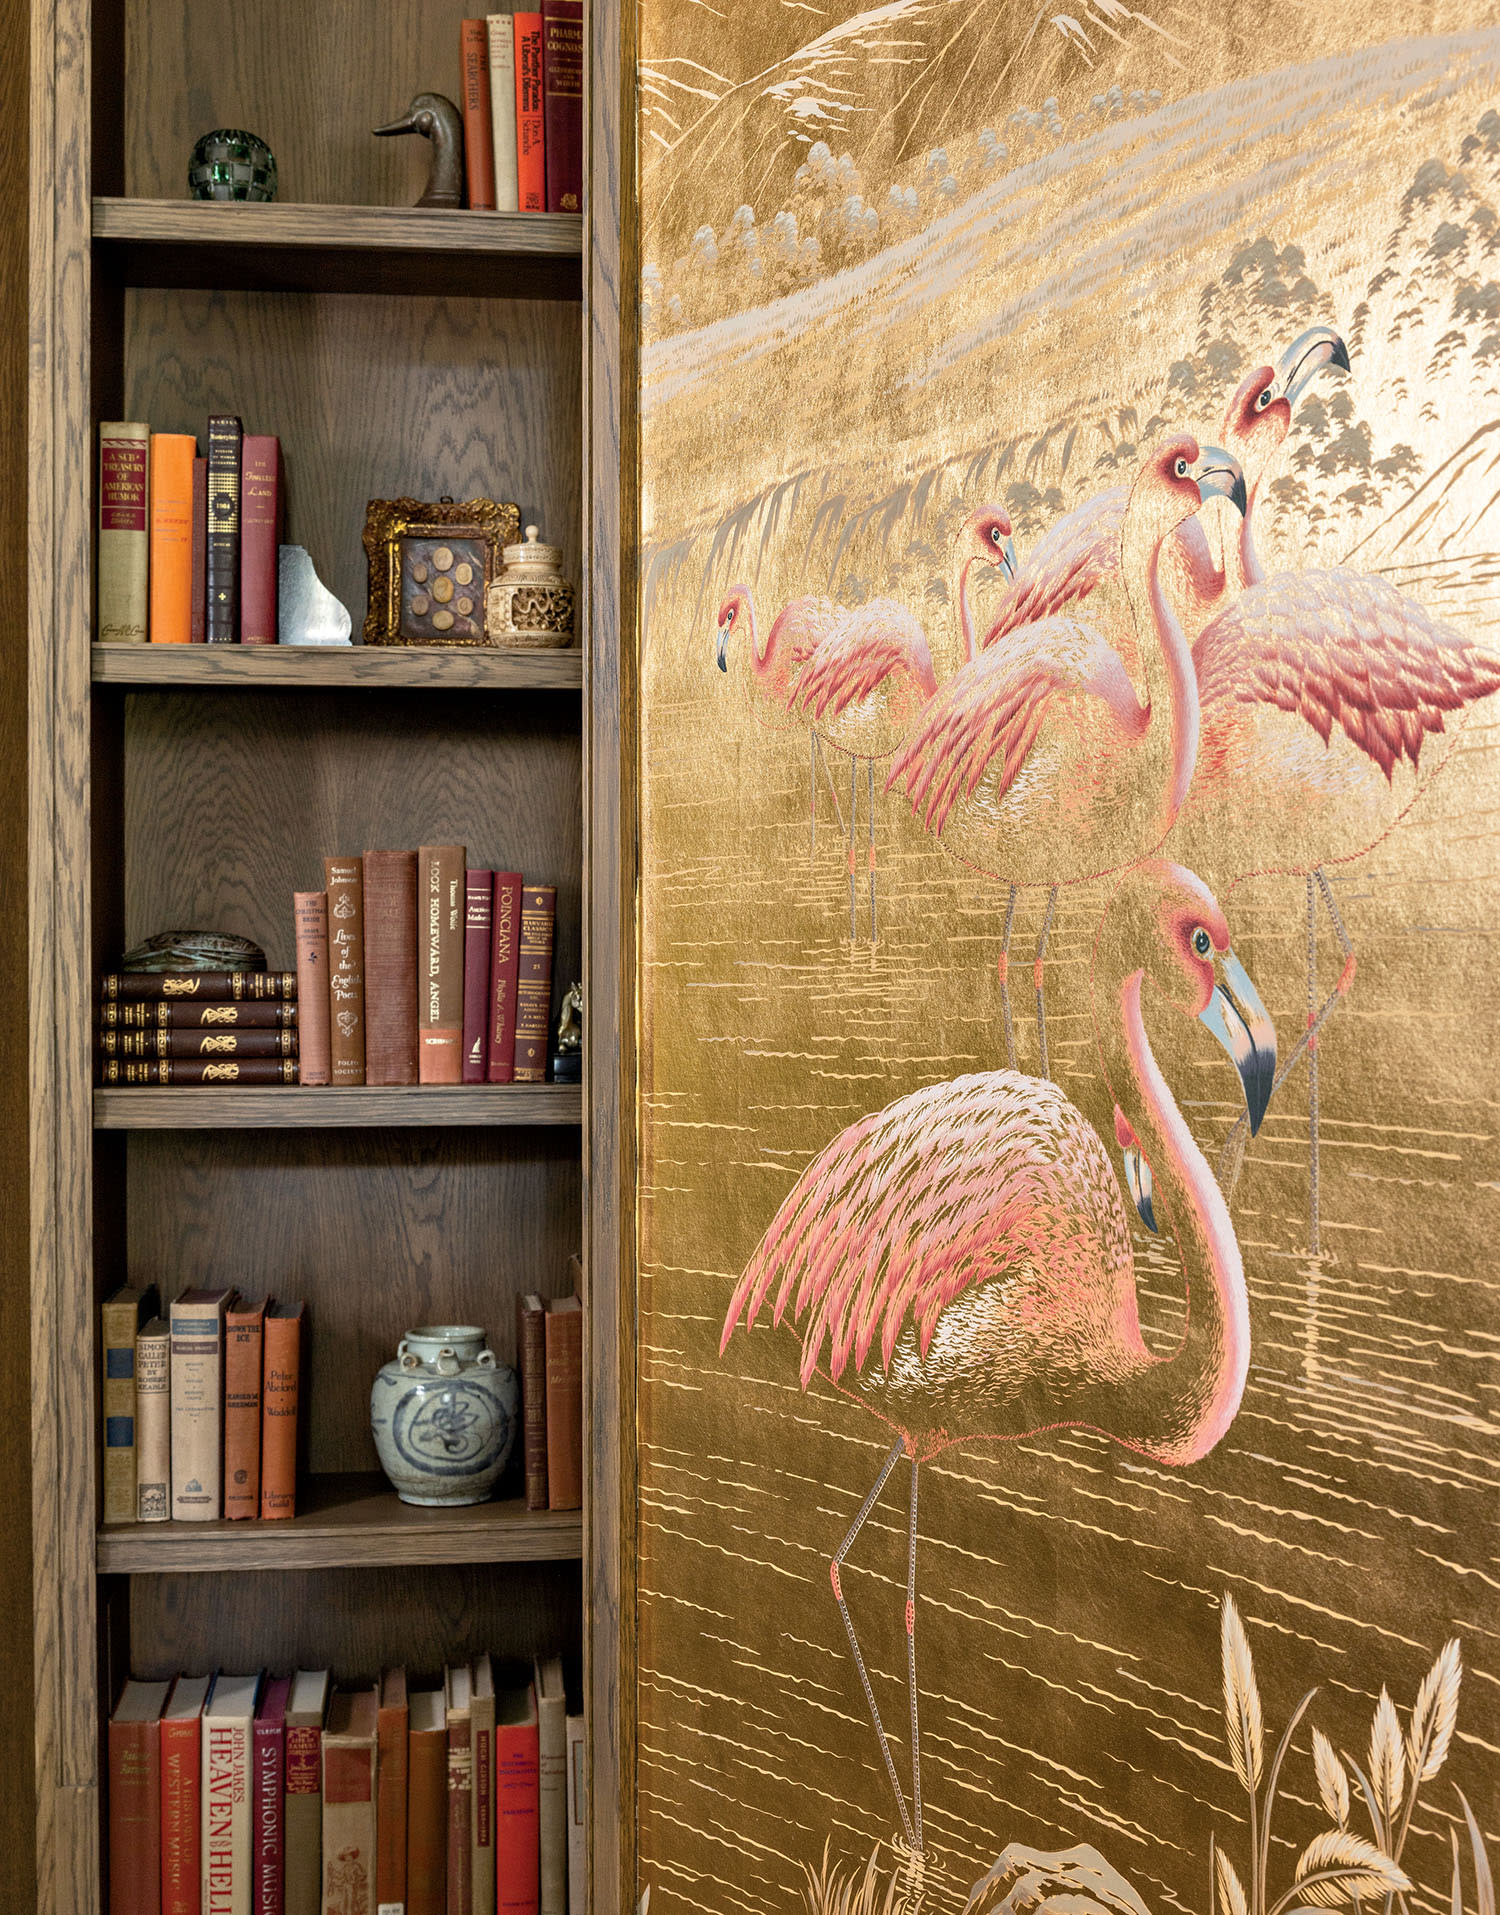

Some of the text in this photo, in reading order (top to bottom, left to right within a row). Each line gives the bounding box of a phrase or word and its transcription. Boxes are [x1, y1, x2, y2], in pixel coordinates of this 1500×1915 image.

[531, 31, 541, 45] The
[550, 28, 582, 39] PHARM
[547, 41, 583, 52] COGNOS
[466, 52, 480, 111] SEARCHERS
[104, 463, 144, 473] TREASURY
[116, 472, 129, 481] OF
[104, 482, 144, 492] AMERICAN
[247, 486, 272, 497] LAND
[108, 492, 139, 502] HUMOR
[330, 866, 357, 874] Samuel
[330, 875, 357, 886] Johnson
[450, 879, 458, 908] Thomas
[499, 885, 513, 965] POINCIANA
[333, 928, 356, 945] Lives
[429, 861, 440, 1023] LOOK HOMEWARD, ANGEL
[340, 945, 350, 959] of
[339, 959, 356, 970] the
[331, 974, 362, 989] English
[248, 1325, 261, 1333] THE
[236, 1334, 250, 1342] ICE
[138, 1343, 166, 1351] SIMON
[138, 1360, 167, 1368] PETER
[270, 1370, 294, 1380] Peter
[265, 1381, 297, 1392] Abelard
[233, 1728, 245, 1804] JOHN JAKES
[183, 1777, 193, 1786] A
[209, 1728, 233, 1838] HEAVEN
[168, 1753, 180, 1832] WESTERN
[262, 1747, 278, 1856] SYMPHONIC
